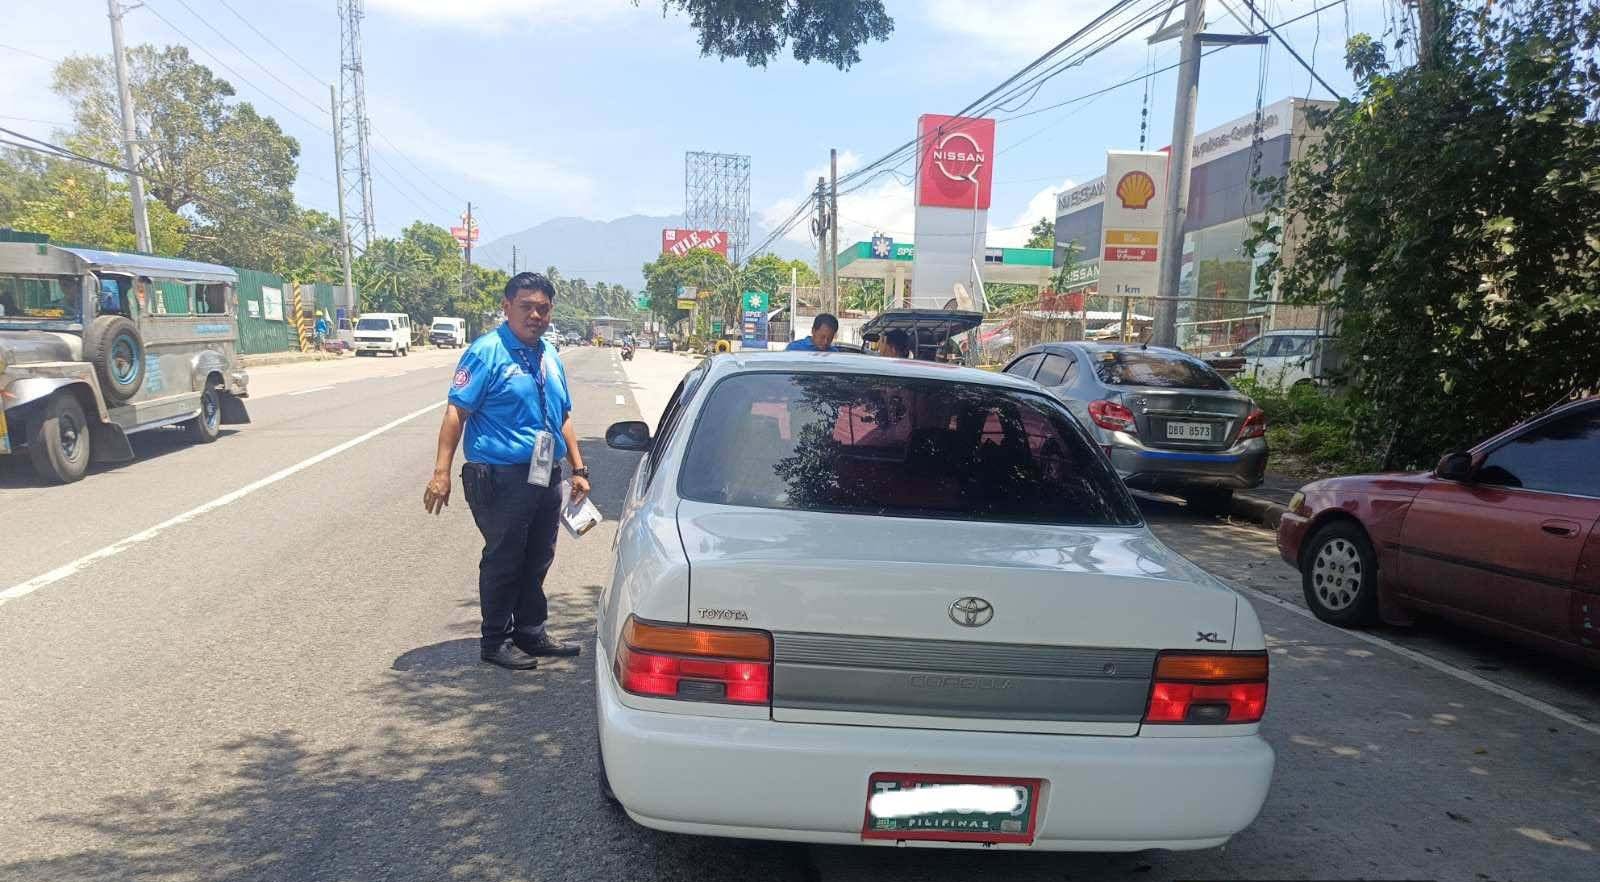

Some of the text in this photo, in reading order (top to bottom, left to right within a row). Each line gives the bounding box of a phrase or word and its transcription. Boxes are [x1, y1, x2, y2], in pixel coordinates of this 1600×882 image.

[933, 151, 985, 163] NISSAN
[670, 231, 702, 255] TILE
[896, 247, 914, 256] SPE
[1124, 284, 1140, 294] km
[698, 608, 750, 621] TOYOTA
[1195, 631, 1227, 644] XL
[908, 818, 990, 829] PILIPINAS
